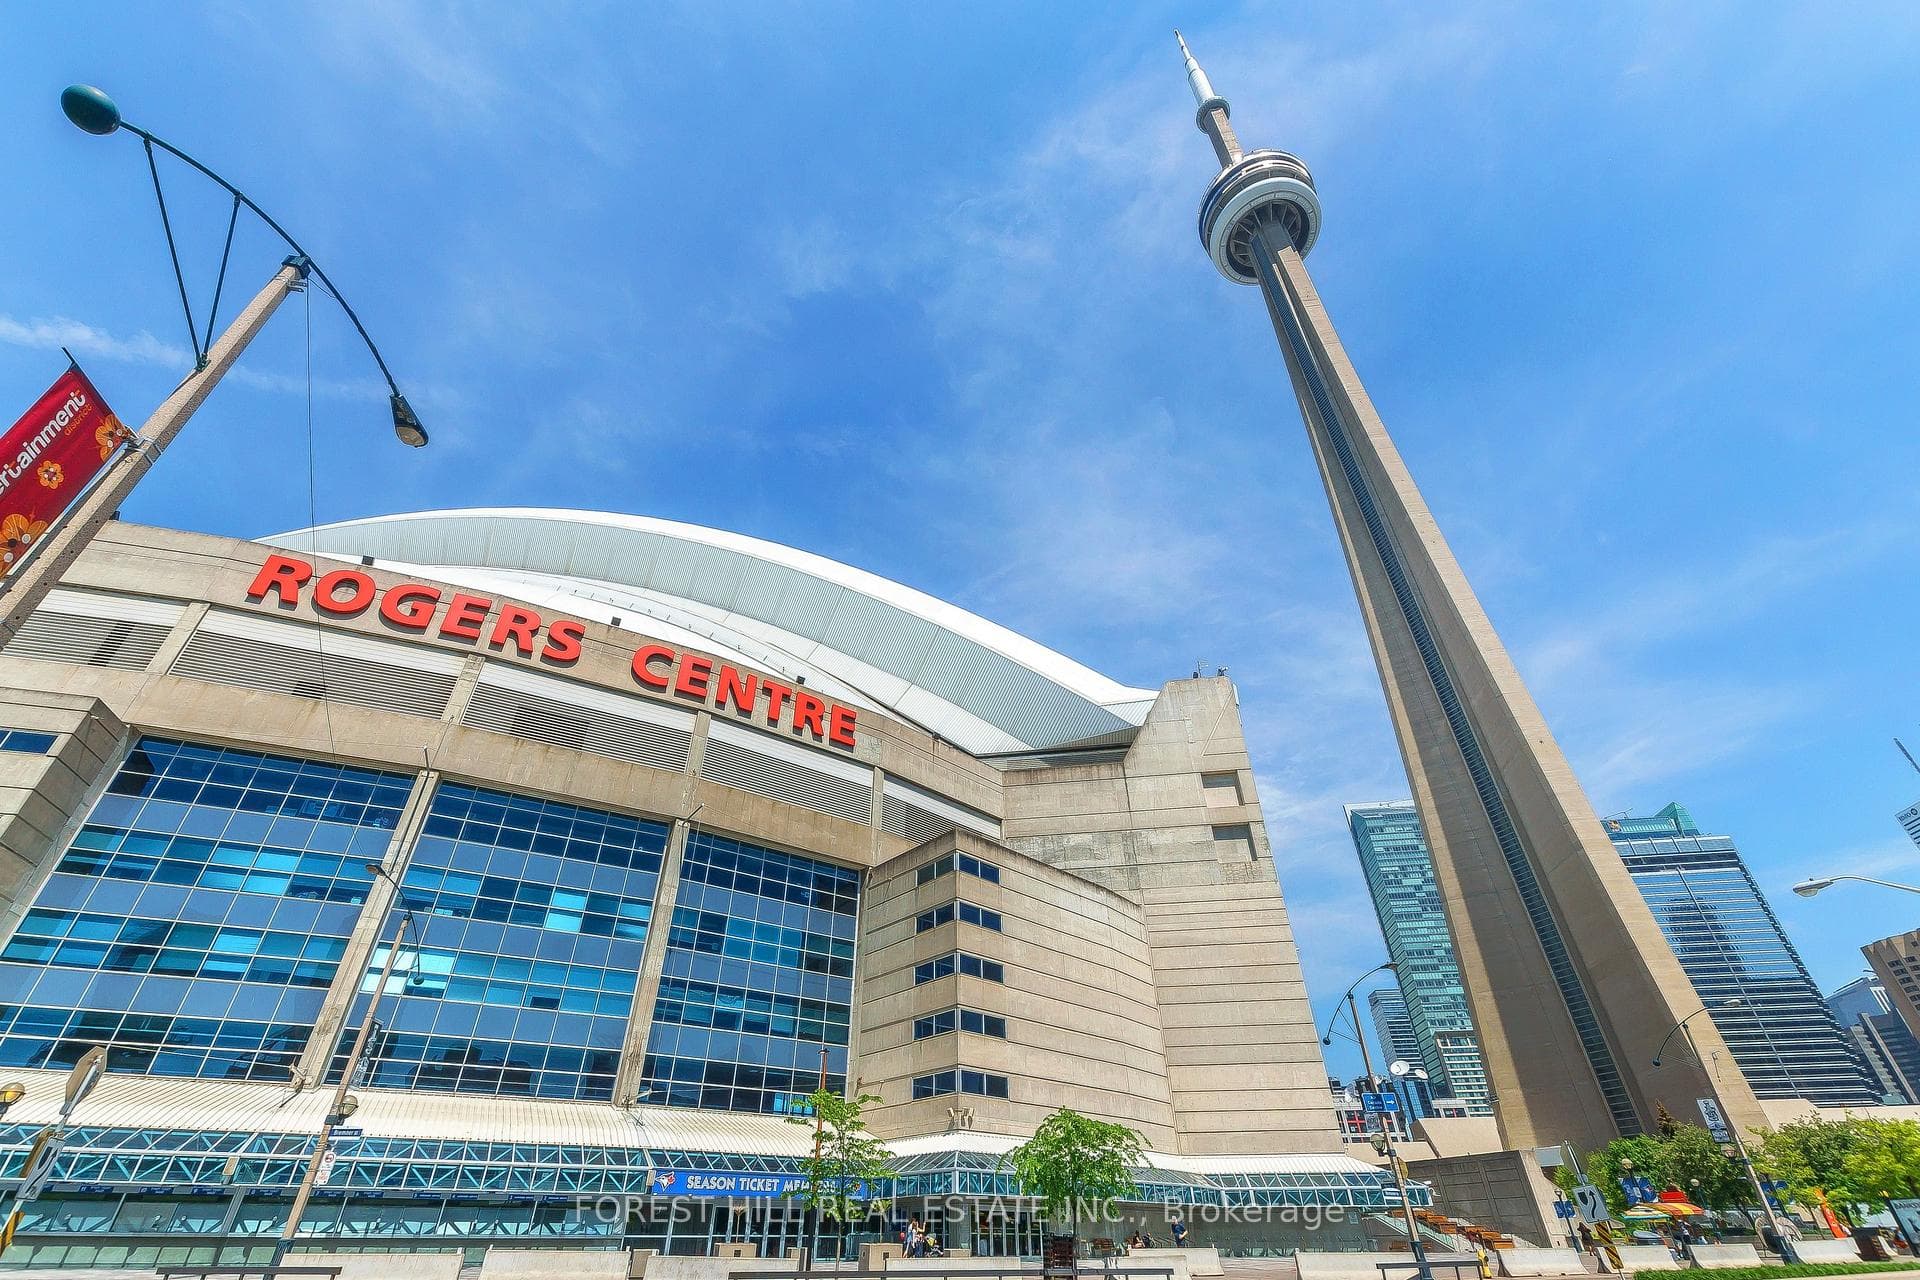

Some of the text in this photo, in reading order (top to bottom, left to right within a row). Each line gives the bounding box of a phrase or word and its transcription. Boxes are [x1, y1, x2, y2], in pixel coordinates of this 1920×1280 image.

[64, 403, 92, 436] district
[247, 554, 857, 747] ROGERS CENTRE
[686, 1175, 736, 1190] SEASON
[739, 1177, 780, 1192] TICKET
